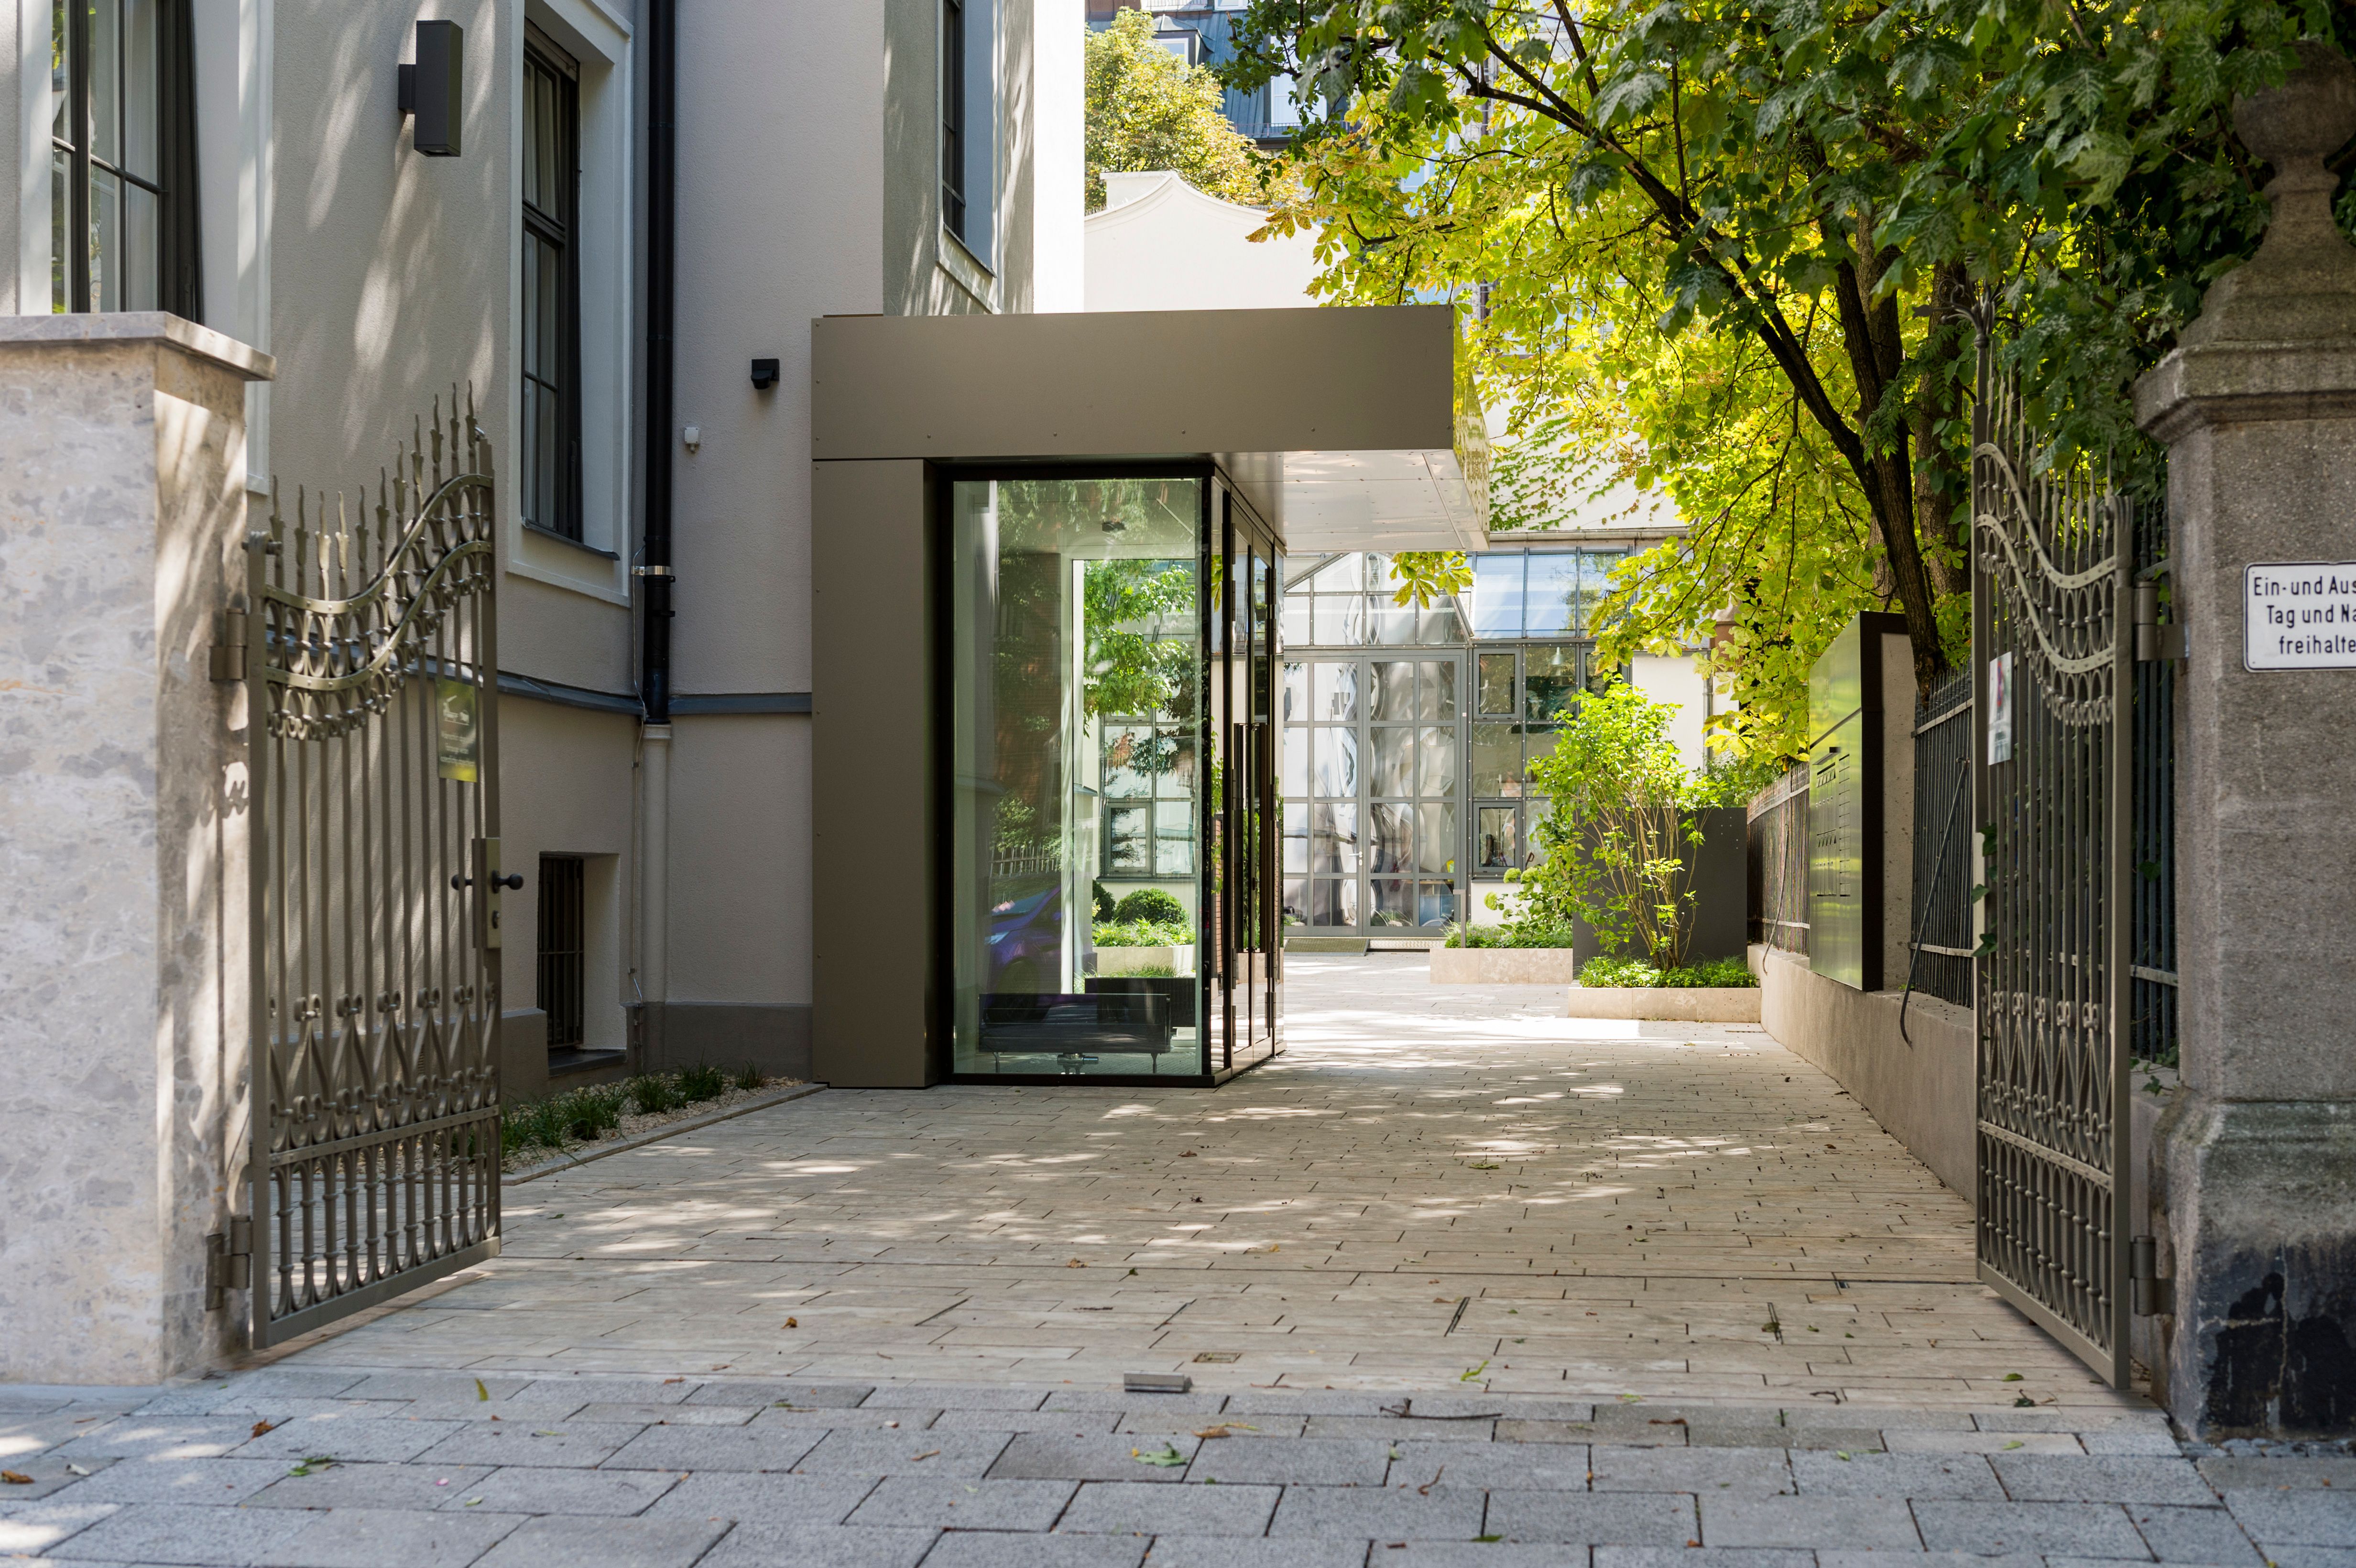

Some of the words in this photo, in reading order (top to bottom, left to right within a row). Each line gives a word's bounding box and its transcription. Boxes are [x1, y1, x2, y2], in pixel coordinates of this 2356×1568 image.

[2267, 605, 2295, 628] Tag
[2302, 604, 2334, 623] und
[2279, 635, 2356, 654] freihalte
